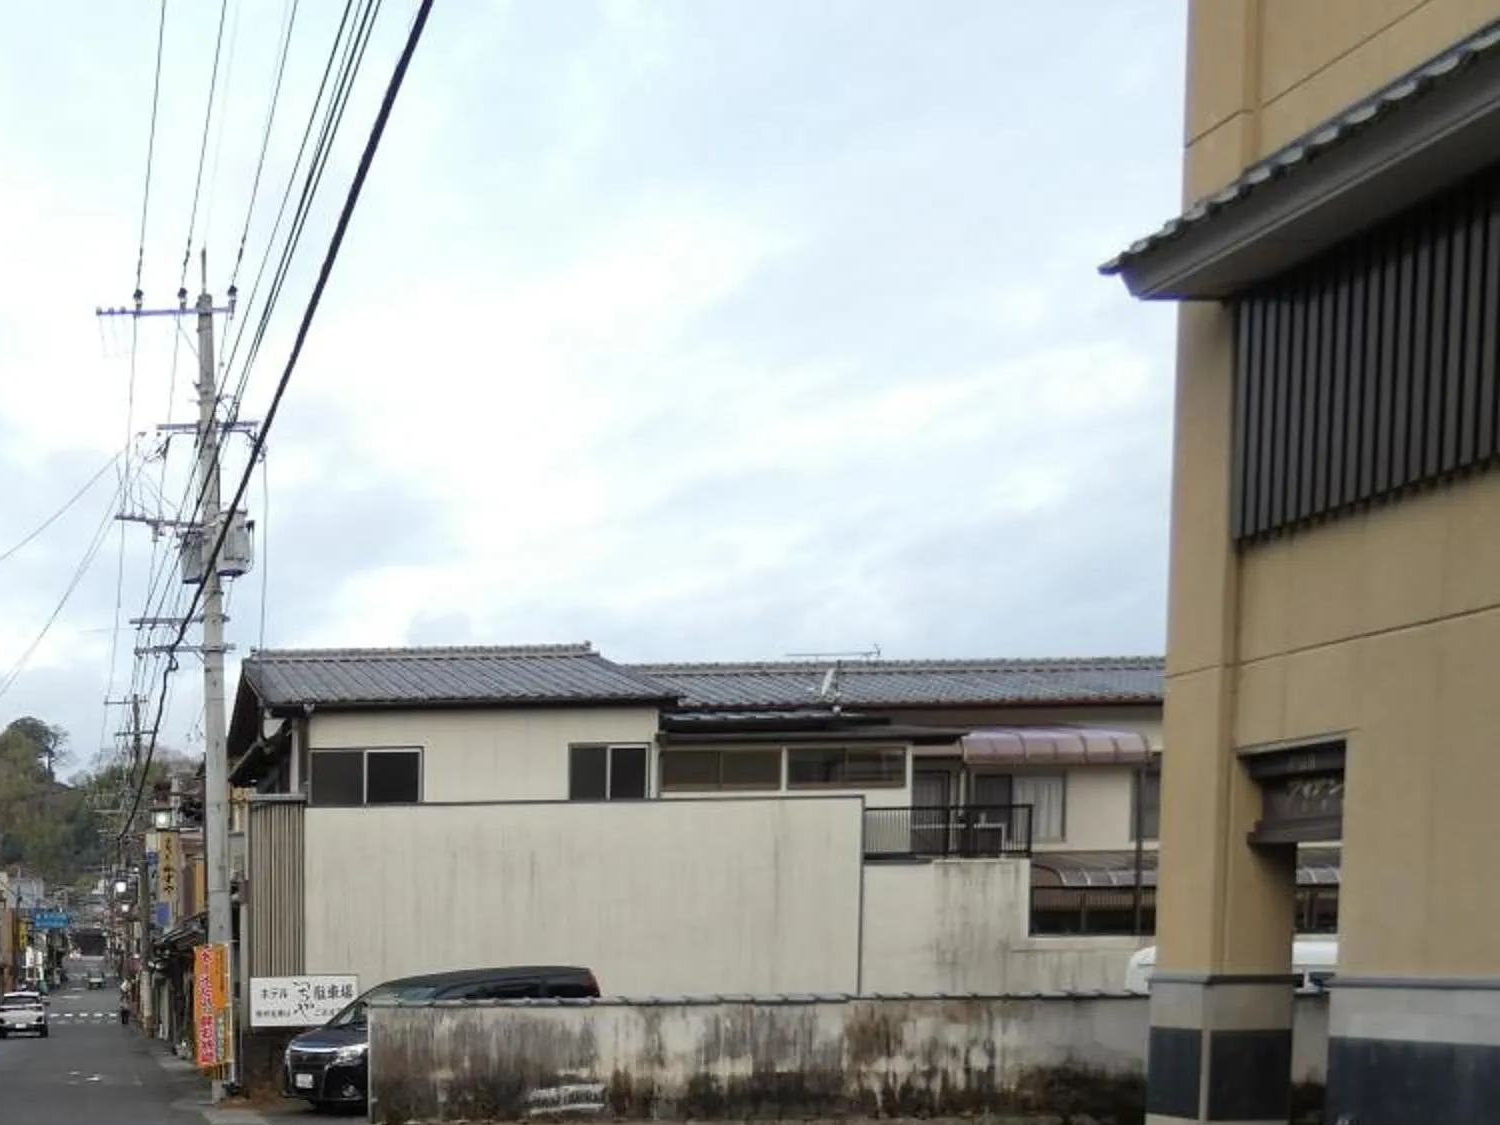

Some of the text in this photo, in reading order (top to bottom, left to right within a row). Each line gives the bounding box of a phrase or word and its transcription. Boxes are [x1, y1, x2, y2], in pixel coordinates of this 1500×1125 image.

[260, 987, 288, 1000] ホテル
[313, 983, 354, 1000] 駐車場
